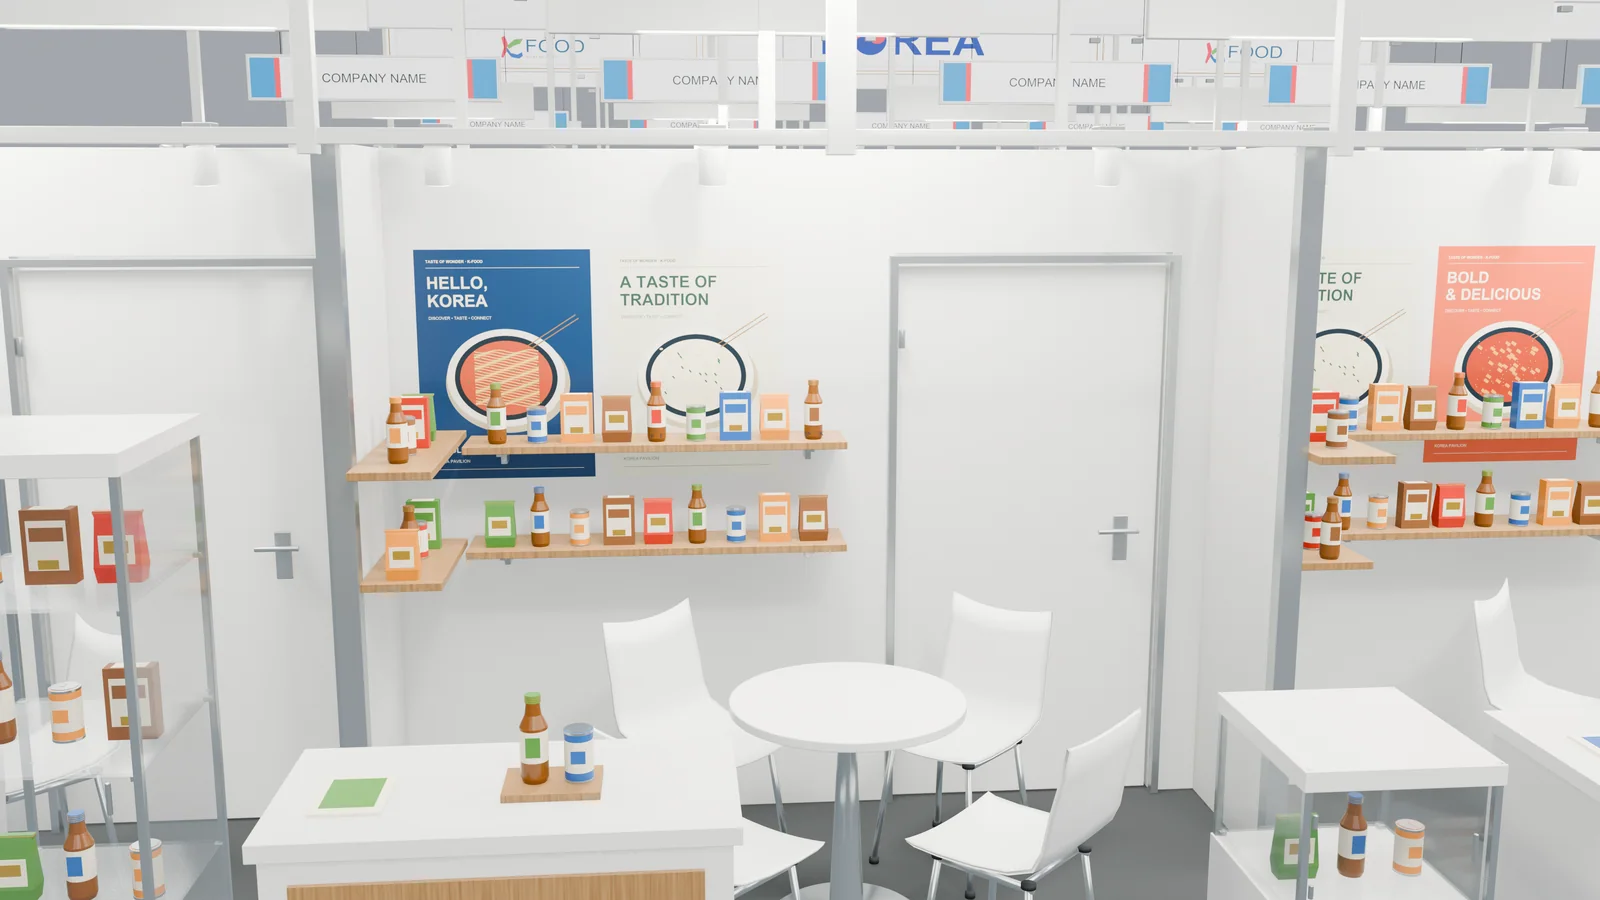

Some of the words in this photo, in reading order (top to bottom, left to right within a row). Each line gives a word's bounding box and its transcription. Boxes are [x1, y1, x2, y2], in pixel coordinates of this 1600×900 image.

[822, 36, 984, 56] REA
[321, 72, 387, 83] COMPANY
[390, 73, 427, 84] NAME
[672, 75, 735, 86] COMPAY
[1009, 77, 1056, 88] COMPA
[1072, 78, 1106, 88] NAME
[1393, 80, 1426, 90] NAME
[426, 275, 488, 292] HELLO,
[620, 275, 632, 288] A
[636, 275, 690, 288] TASTE
[695, 275, 717, 288] OF
[1341, 272, 1362, 284] OF
[1447, 271, 1490, 284] BOLD
[620, 293, 709, 306] TRADITION
[1445, 288, 1457, 301] &
[1460, 287, 1541, 301] DELICIOUS
[427, 294, 488, 308] KOREA
